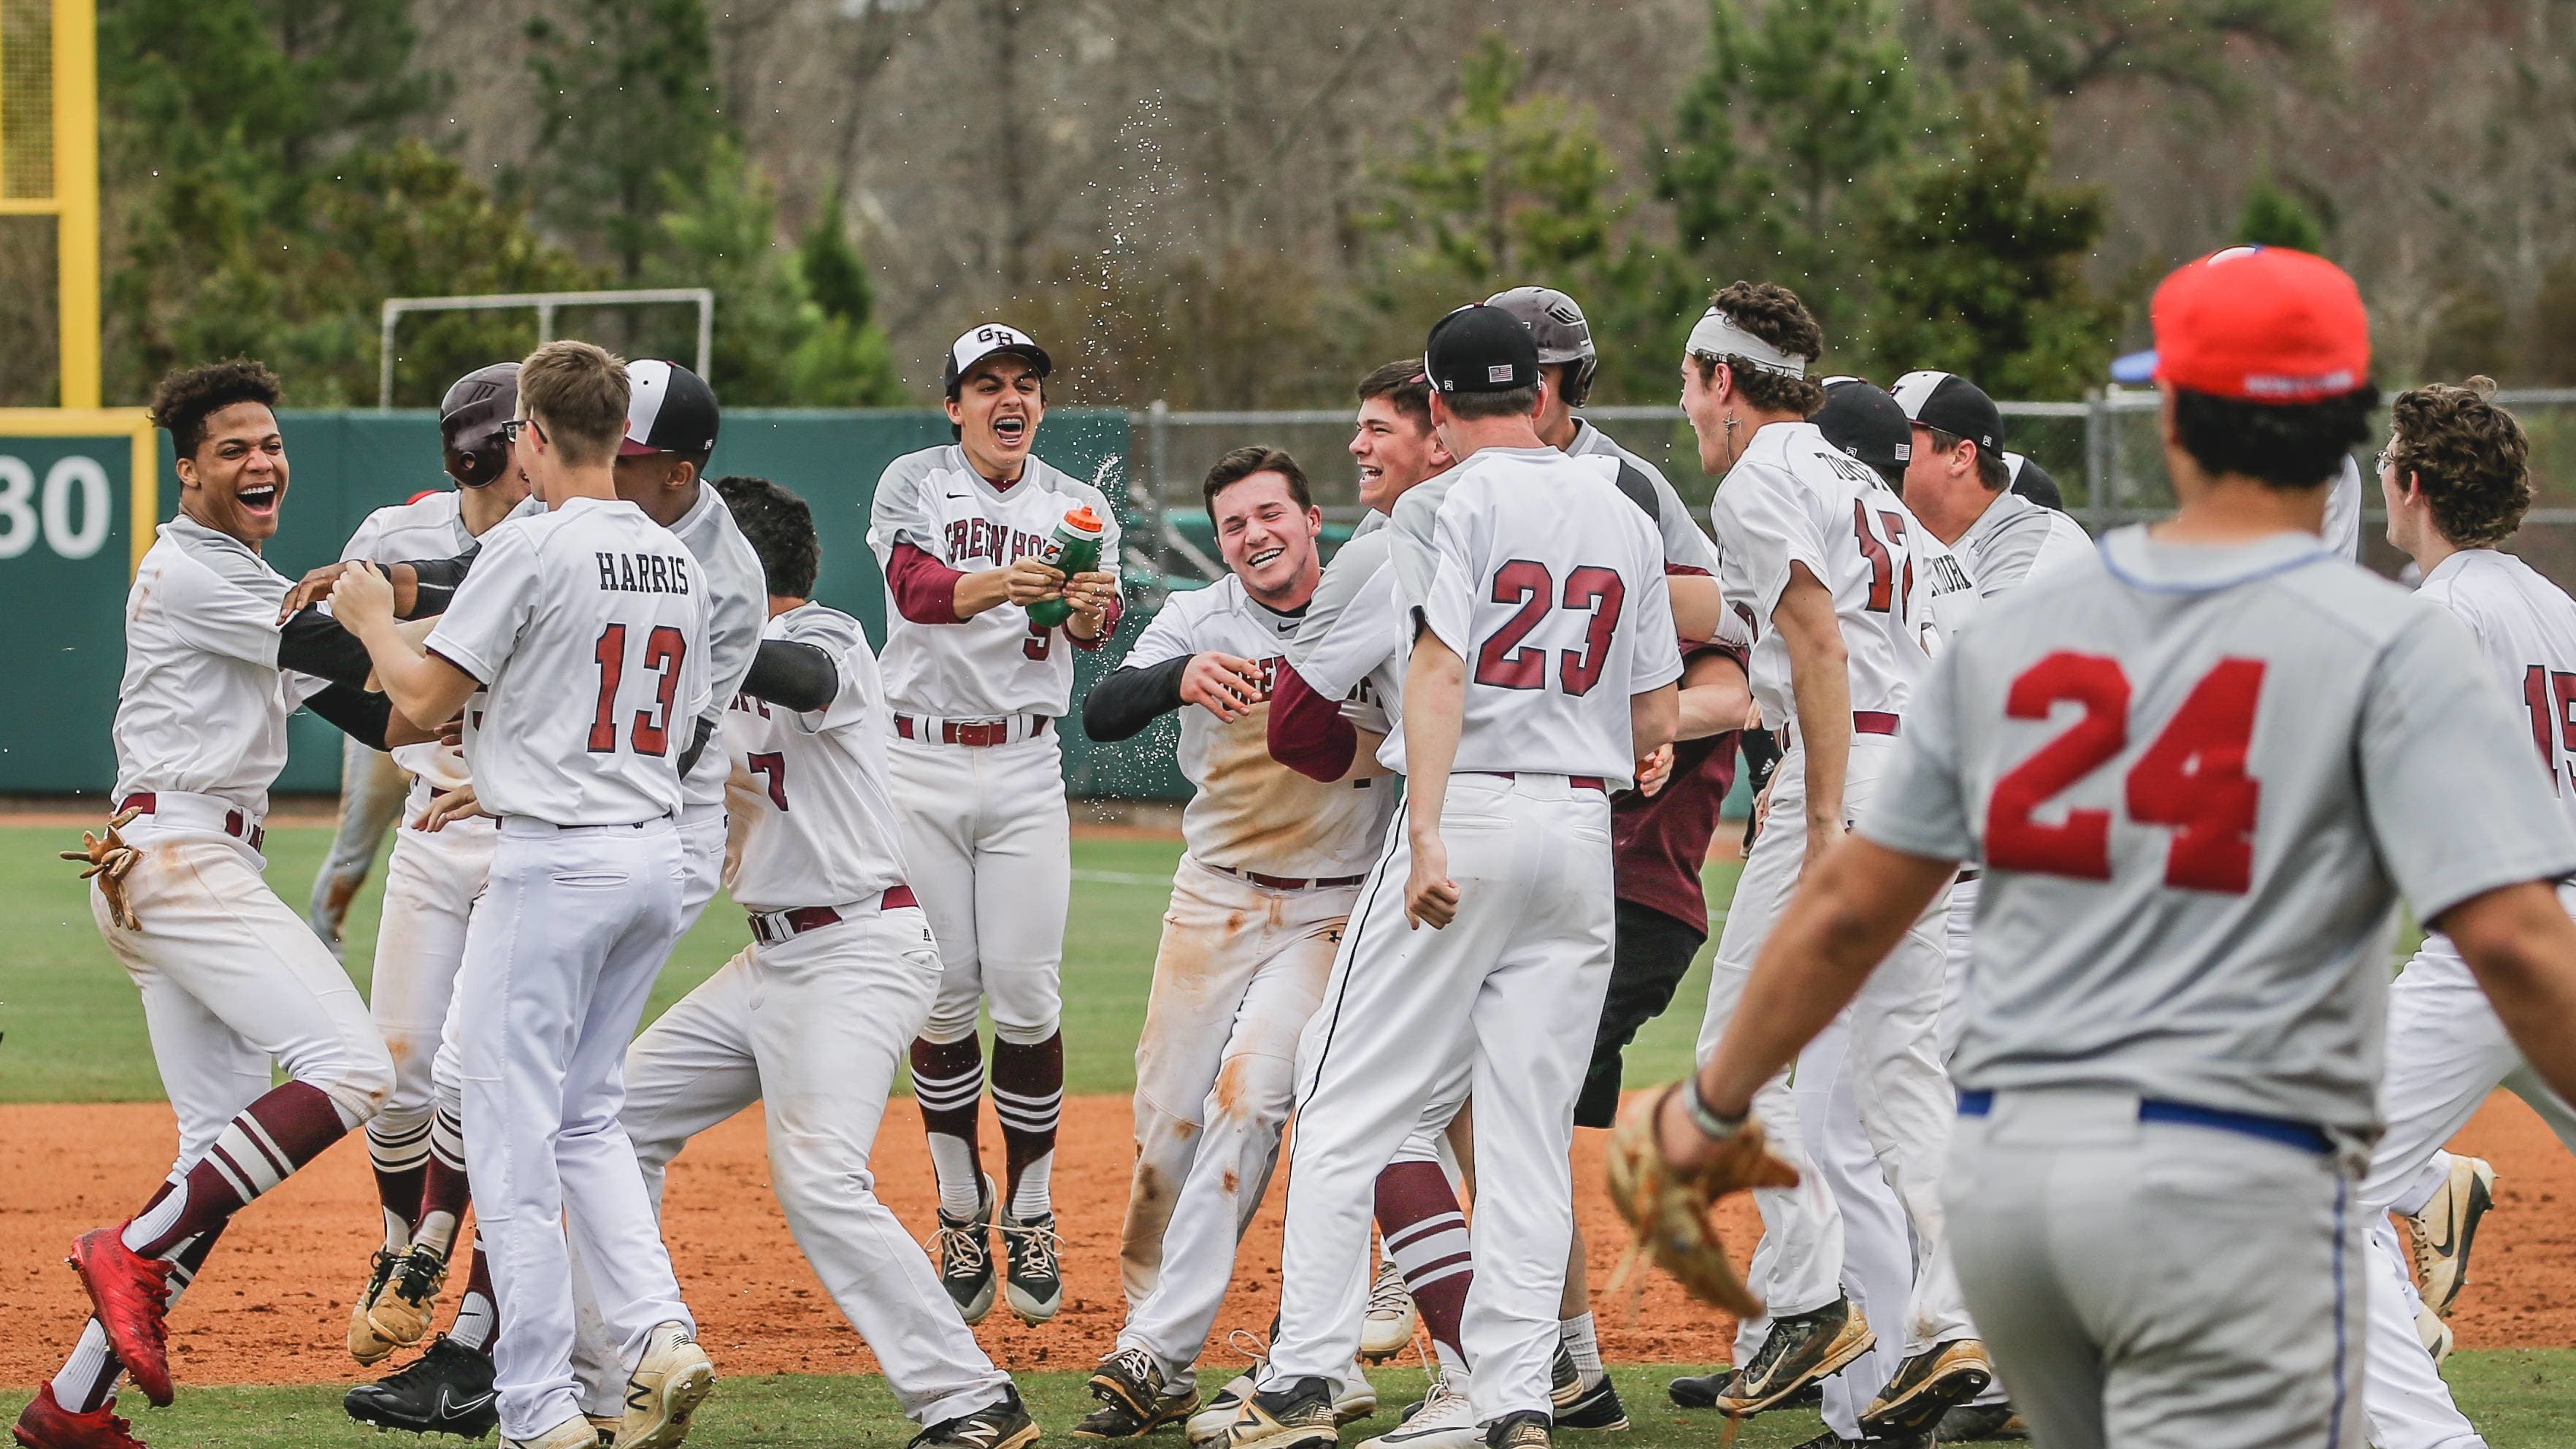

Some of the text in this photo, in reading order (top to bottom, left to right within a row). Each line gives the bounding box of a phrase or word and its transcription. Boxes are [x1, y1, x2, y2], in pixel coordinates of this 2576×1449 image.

[977, 328, 1014, 345] GH
[596, 552, 688, 595] HARRIS
[1010, 529, 1047, 566] HO
[1473, 559, 1625, 697] 23
[587, 622, 686, 757] 13
[747, 751, 789, 812] 7
[1985, 649, 2267, 897] 24
